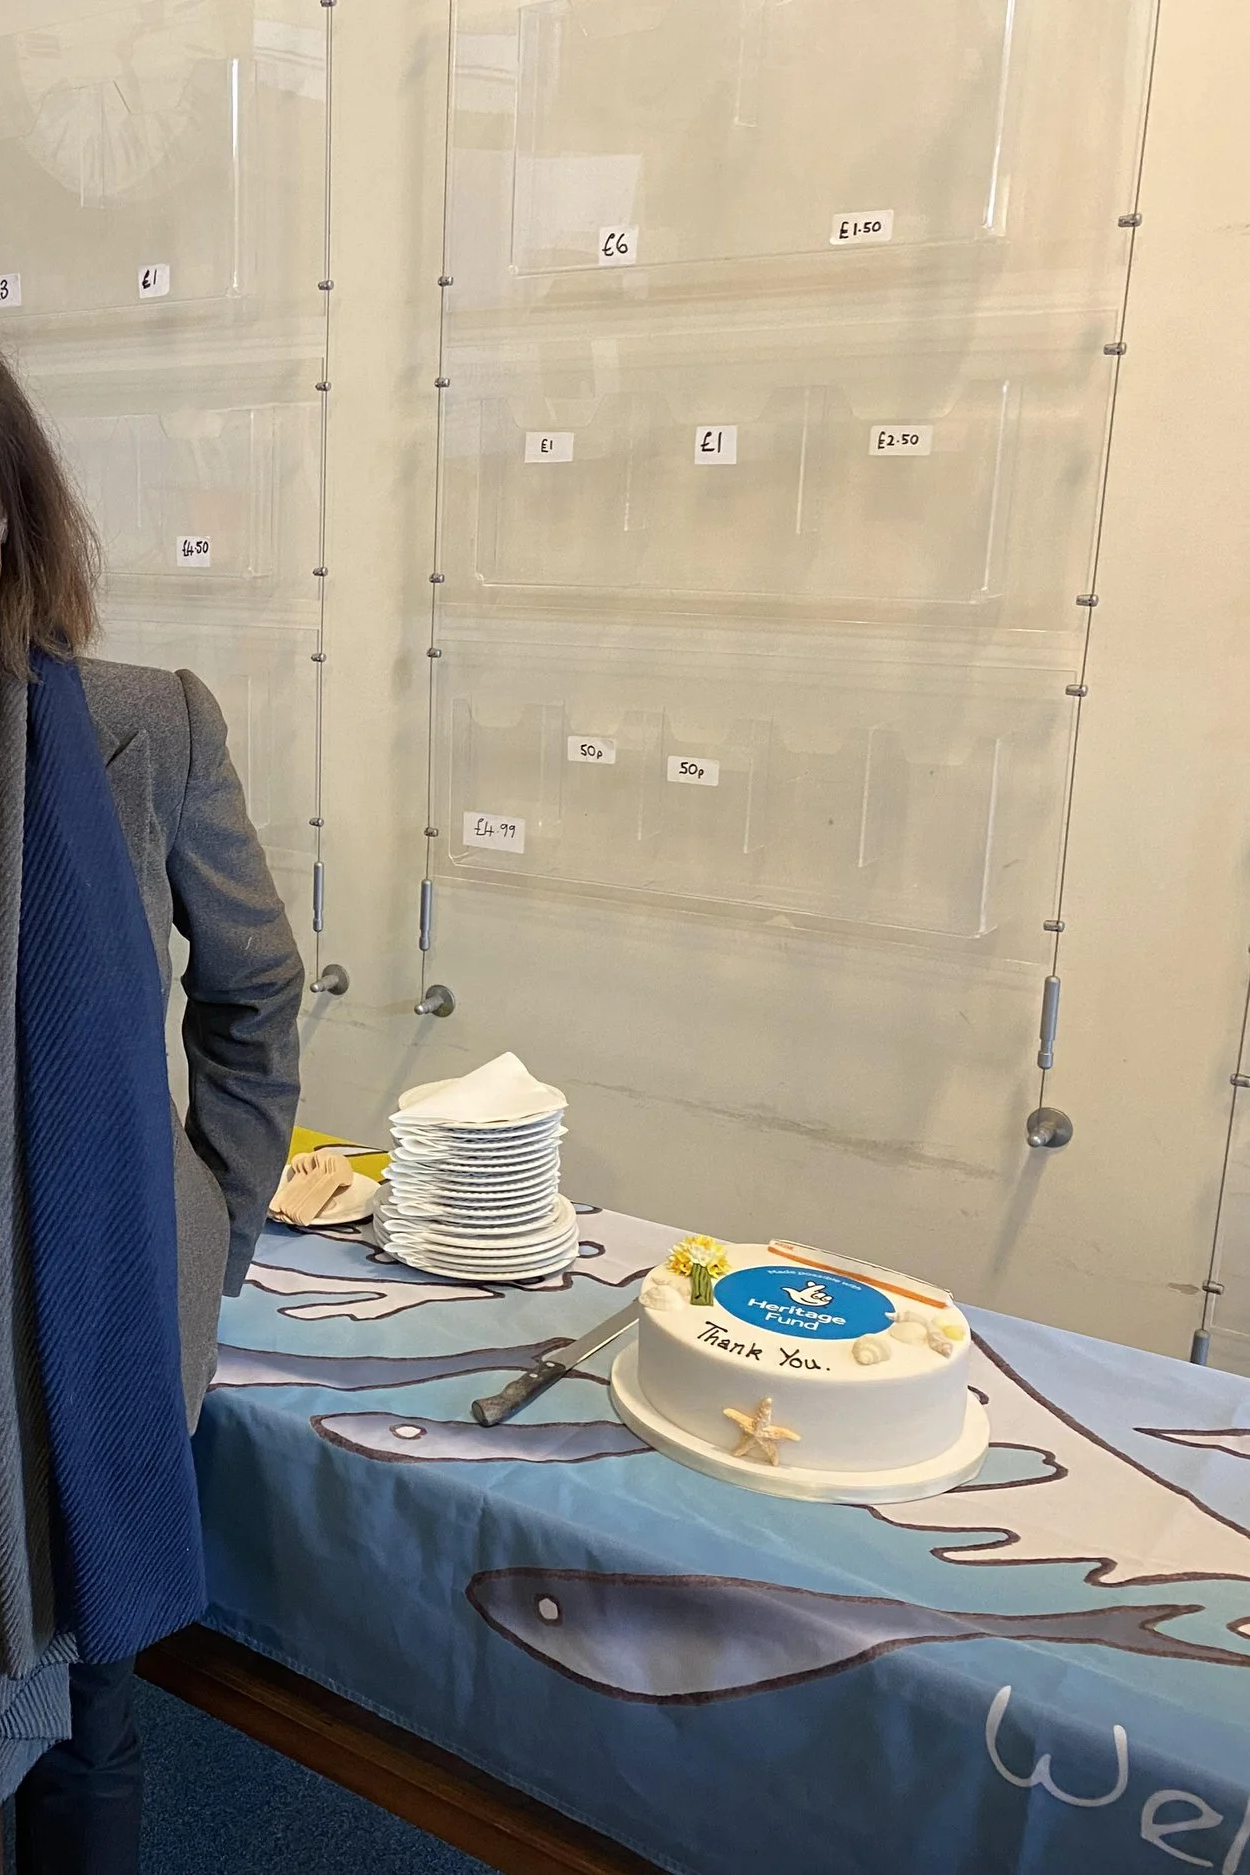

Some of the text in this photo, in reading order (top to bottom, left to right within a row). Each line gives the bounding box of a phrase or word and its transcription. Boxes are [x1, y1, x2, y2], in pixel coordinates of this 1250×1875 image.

[838, 220, 882, 240] £1.50
[601, 232, 629, 257] £6
[141, 268, 158, 290] £1
[540, 438, 554, 454] £1
[699, 430, 722, 453] £1
[877, 432, 920, 450] £2.50
[181, 539, 209, 557] £4.50
[580, 743, 604, 760] 50p
[678, 761, 705, 779] 50p
[473, 817, 517, 839] £4.99
[747, 1298, 847, 1326] Heritage
[765, 1311, 821, 1331] Fund
[696, 1320, 831, 1372] Thank You.
